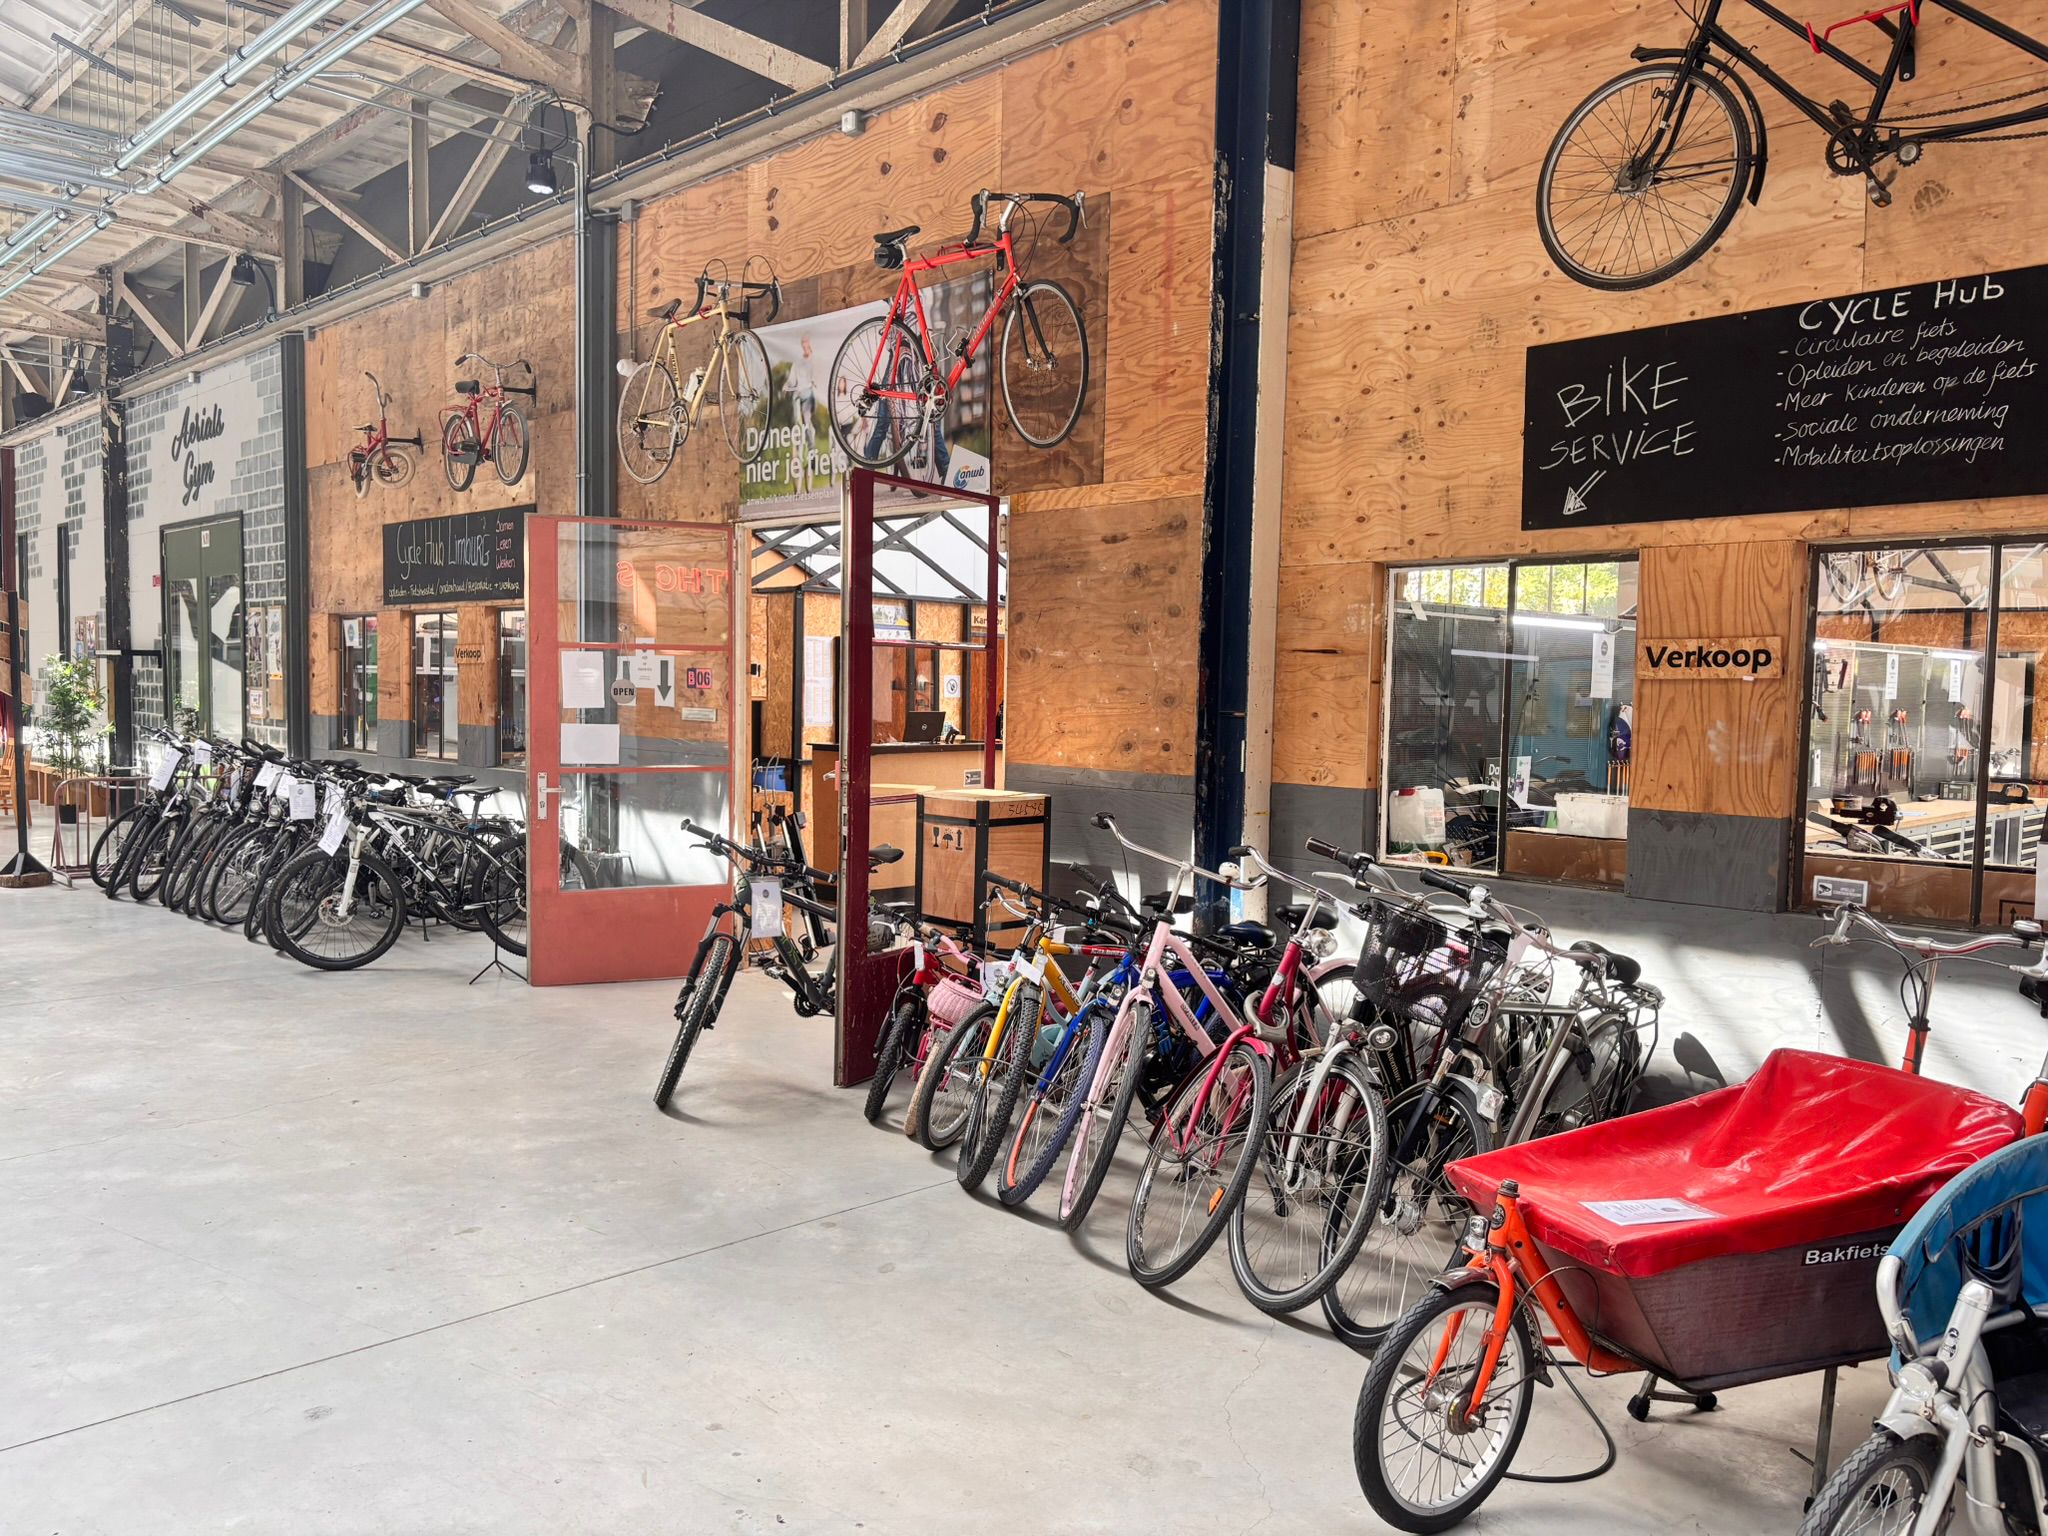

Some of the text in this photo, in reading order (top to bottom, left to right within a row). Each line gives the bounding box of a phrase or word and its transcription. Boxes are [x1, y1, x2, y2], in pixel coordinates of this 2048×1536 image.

[1800, 275, 2005, 335] CYCLE Hub
[1795, 327, 1904, 357] Circulaire
[1910, 318, 1957, 350] fiets
[1787, 355, 1877, 390] Opleiden
[1883, 351, 1907, 367] en
[1916, 335, 2025, 365] begeleiden
[1933, 376, 1960, 396] op
[1963, 366, 1987, 385] de
[1983, 357, 2039, 397] fiets
[1870, 401, 2009, 429] onderneming
[172, 403, 224, 462] Aerials
[746, 424, 808, 452] Doneer
[183, 451, 215, 506] Gym
[784, 452, 801, 485] je
[960, 466, 985, 479] anwb
[397, 522, 421, 580] Cycle
[425, 520, 445, 567] Hub
[455, 648, 482, 660] Verkoop
[1646, 645, 1772, 674] Verkoop
[613, 688, 635, 696] OPEN
[1805, 1243, 1890, 1265] Bakfiets
